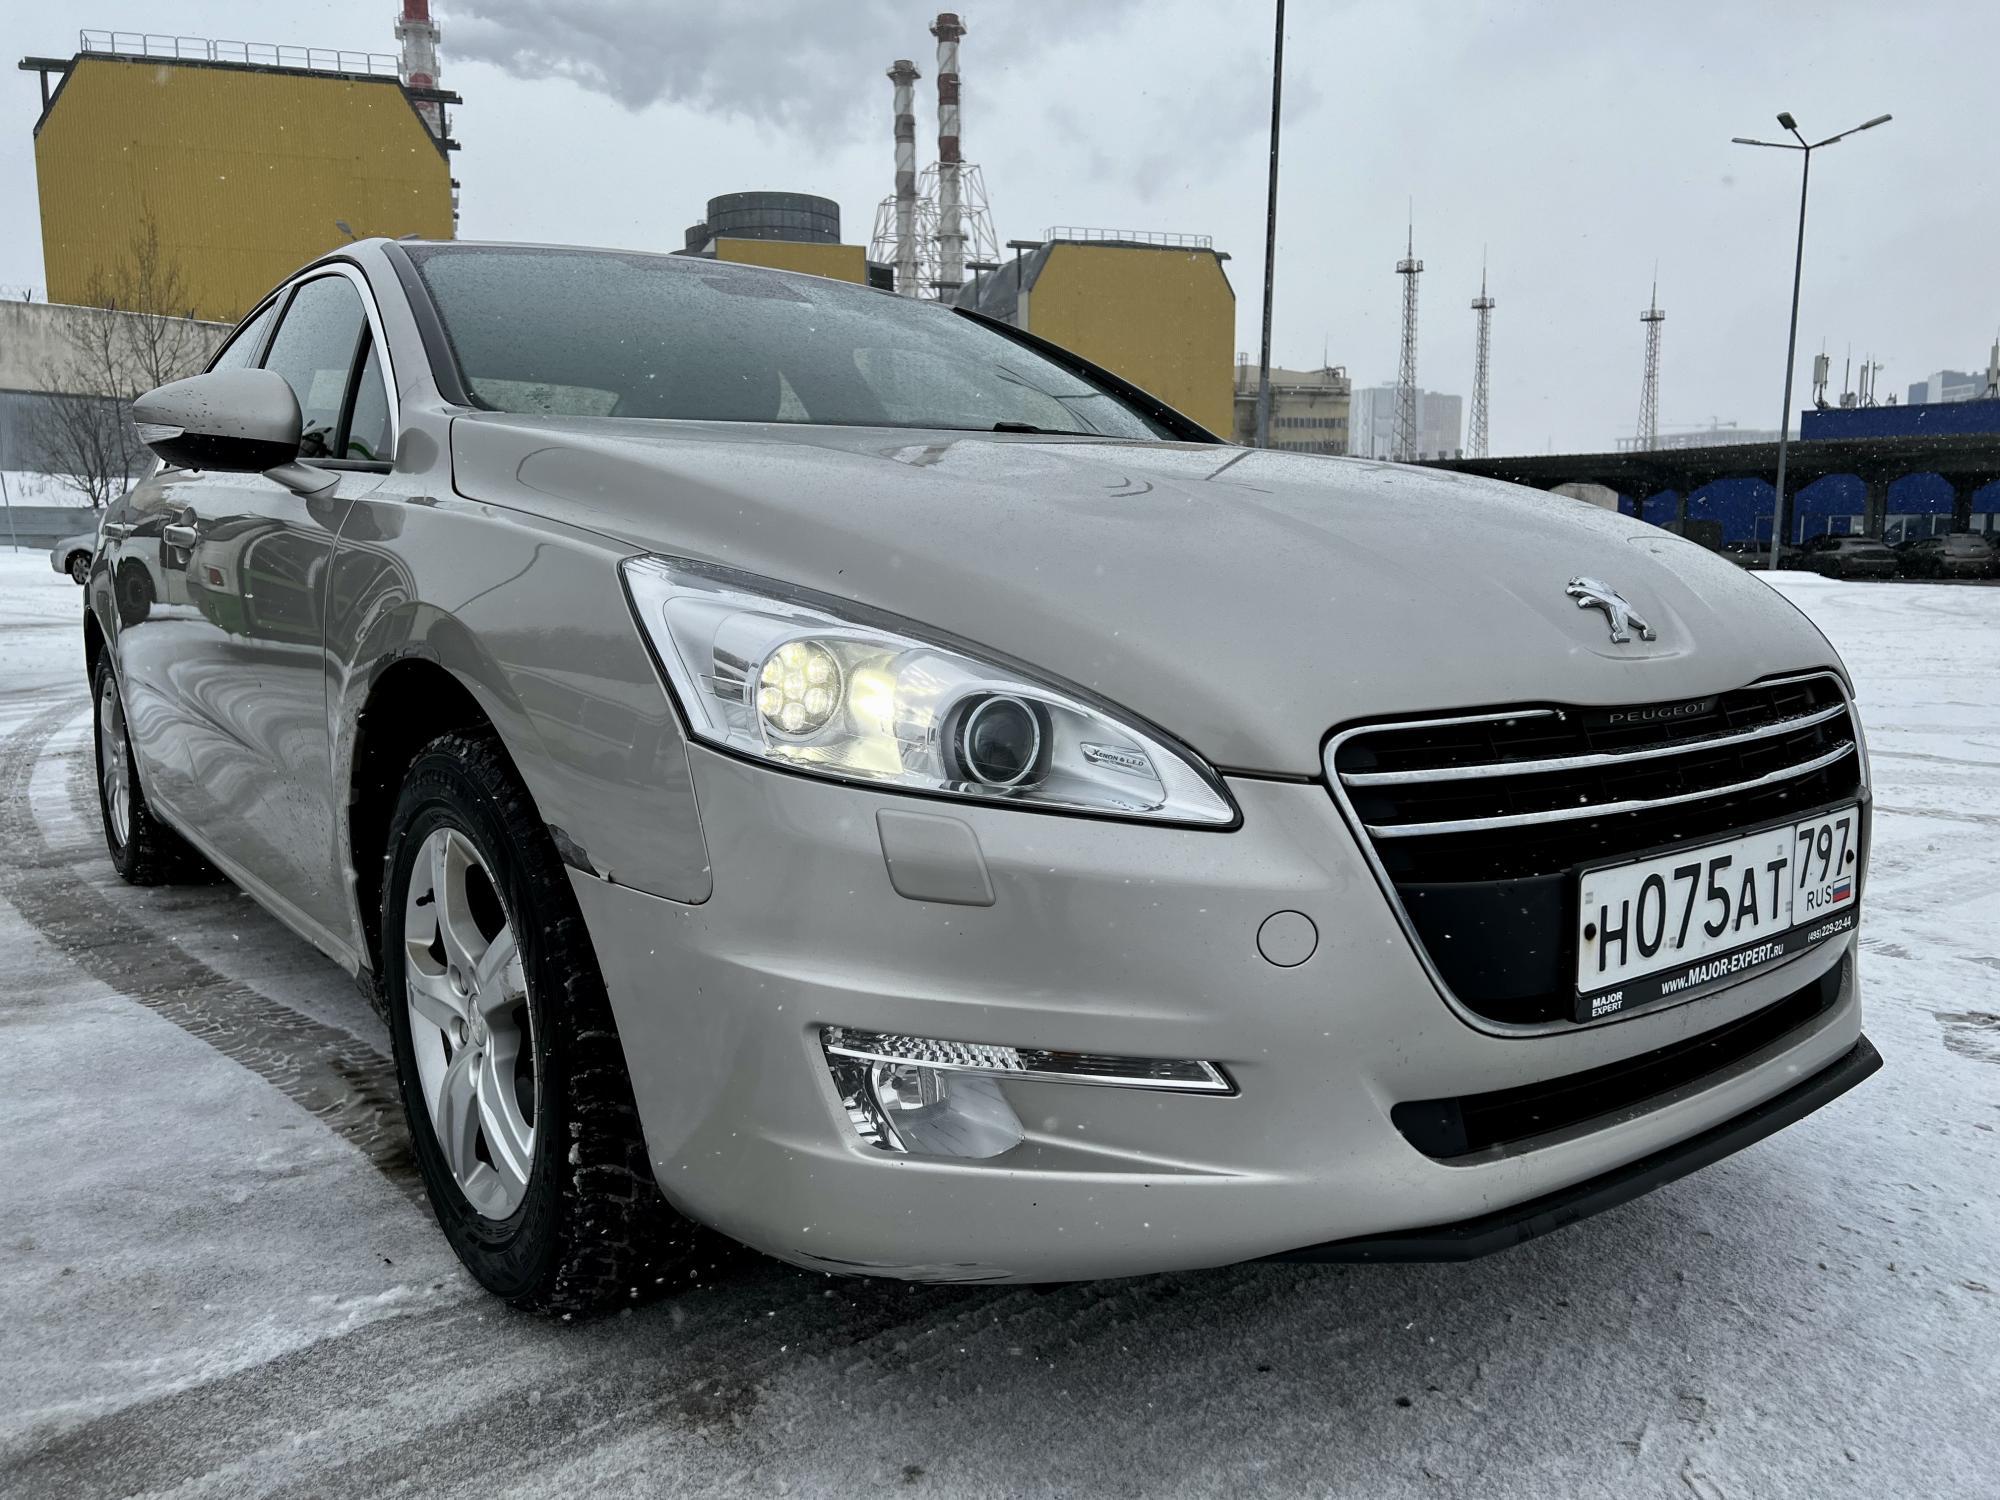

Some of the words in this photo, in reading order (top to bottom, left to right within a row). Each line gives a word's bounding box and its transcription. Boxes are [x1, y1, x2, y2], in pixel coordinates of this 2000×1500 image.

[1609, 703, 1705, 723] PEUGEOT
[1798, 817, 1851, 889] 797
[1806, 885, 1832, 912] RUS
[1591, 1000, 1623, 1017] EXPERT
[1592, 991, 1623, 1009] MAJOR
